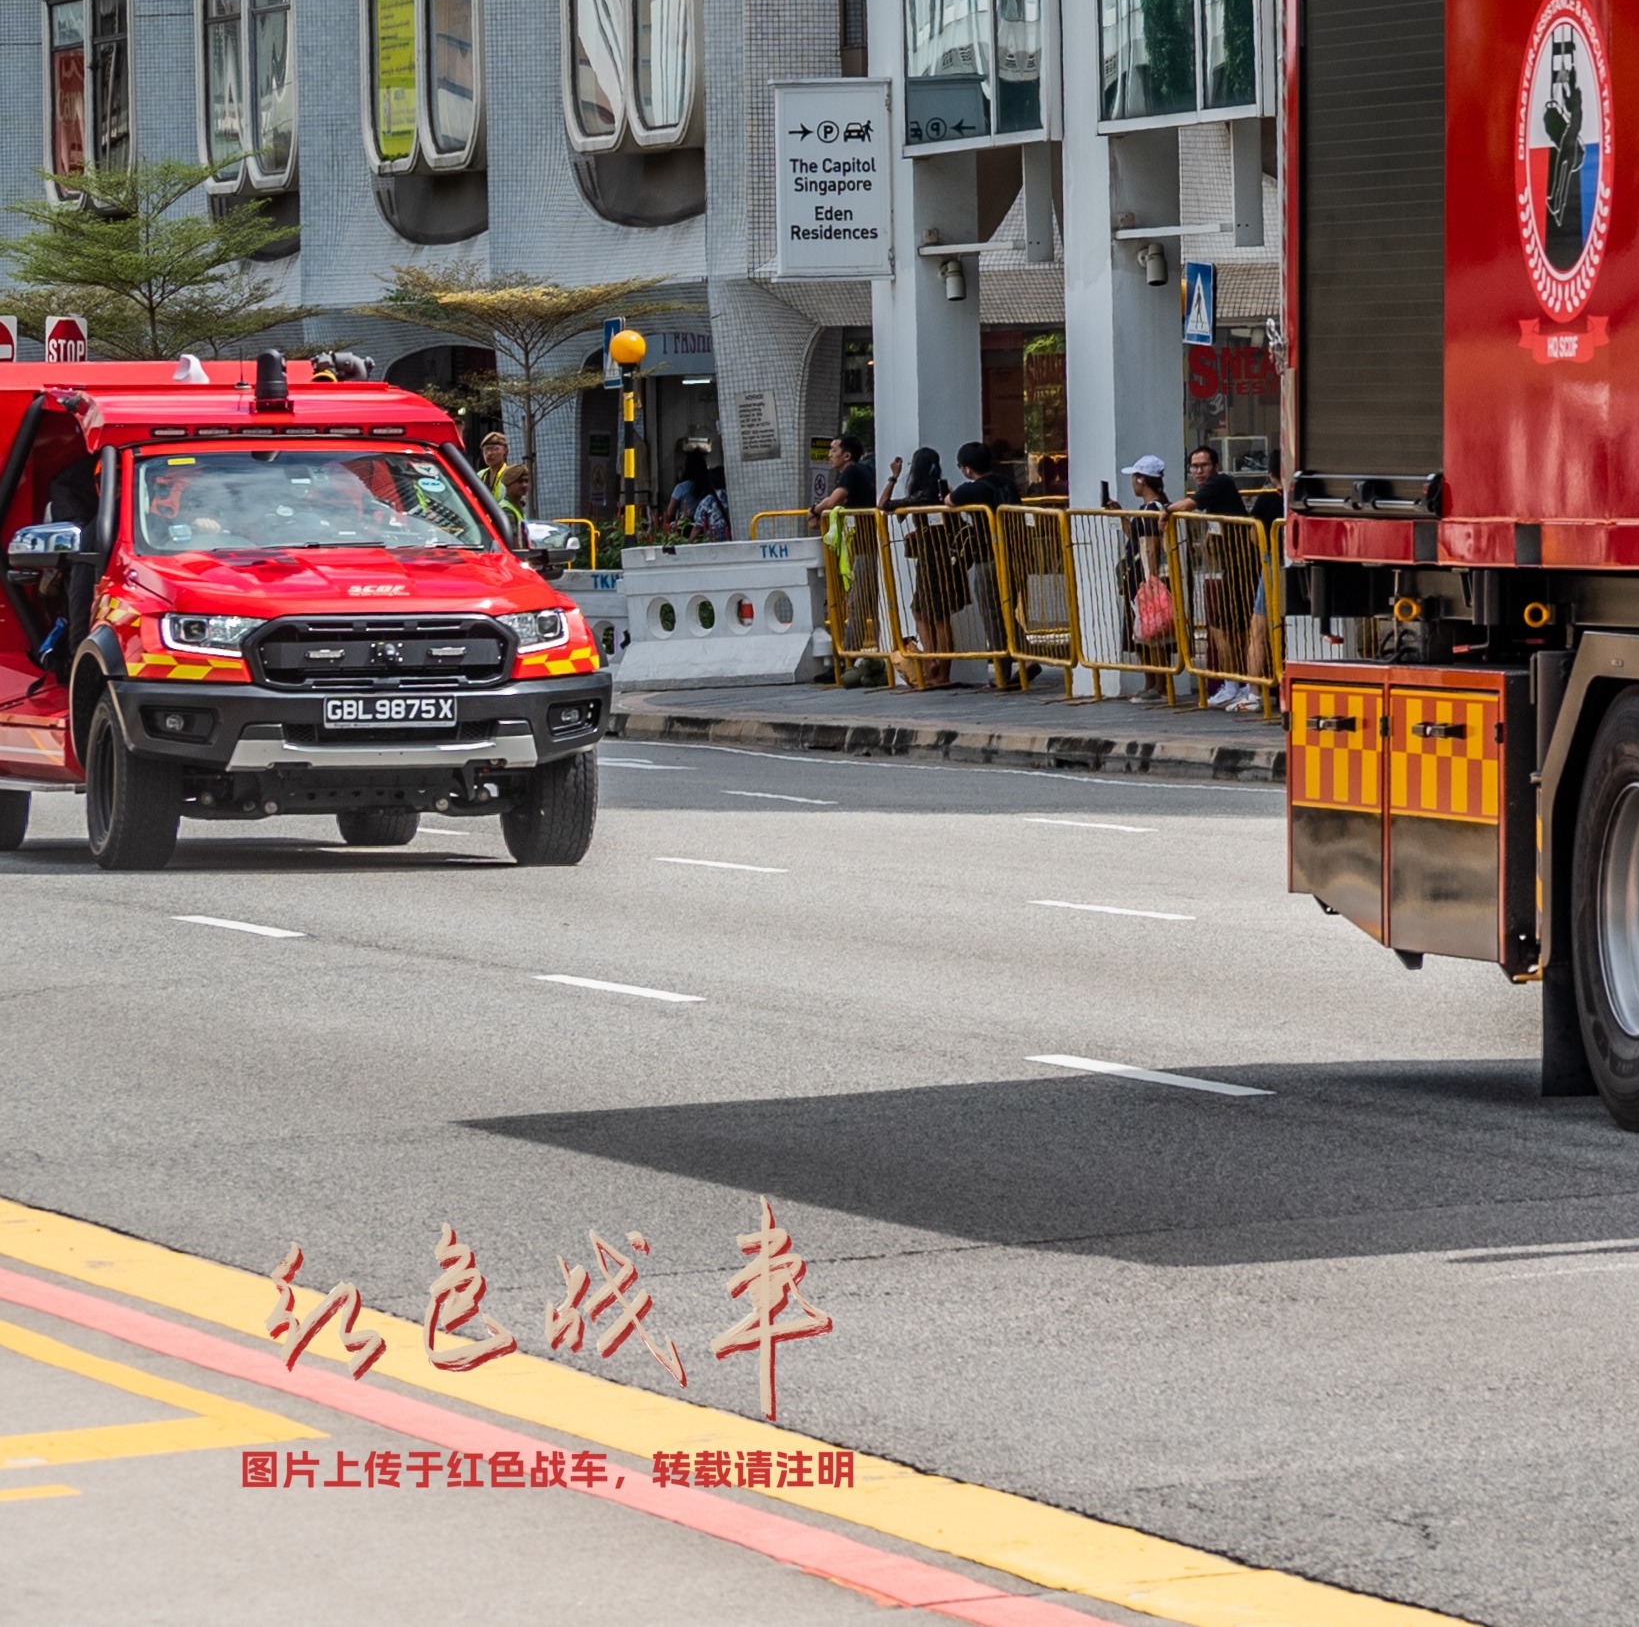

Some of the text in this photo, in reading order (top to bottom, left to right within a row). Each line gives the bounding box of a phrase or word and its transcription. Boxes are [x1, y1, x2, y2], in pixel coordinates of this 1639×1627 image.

[1517, 48, 1536, 161] DISASTER
[1601, 84, 1612, 155] TEAM
[789, 156, 877, 177] The Capitol
[794, 177, 872, 195] Singapore
[814, 205, 853, 221] Eden
[790, 224, 879, 241] Residences
[48, 338, 85, 362] STOP
[759, 544, 789, 559] TKH
